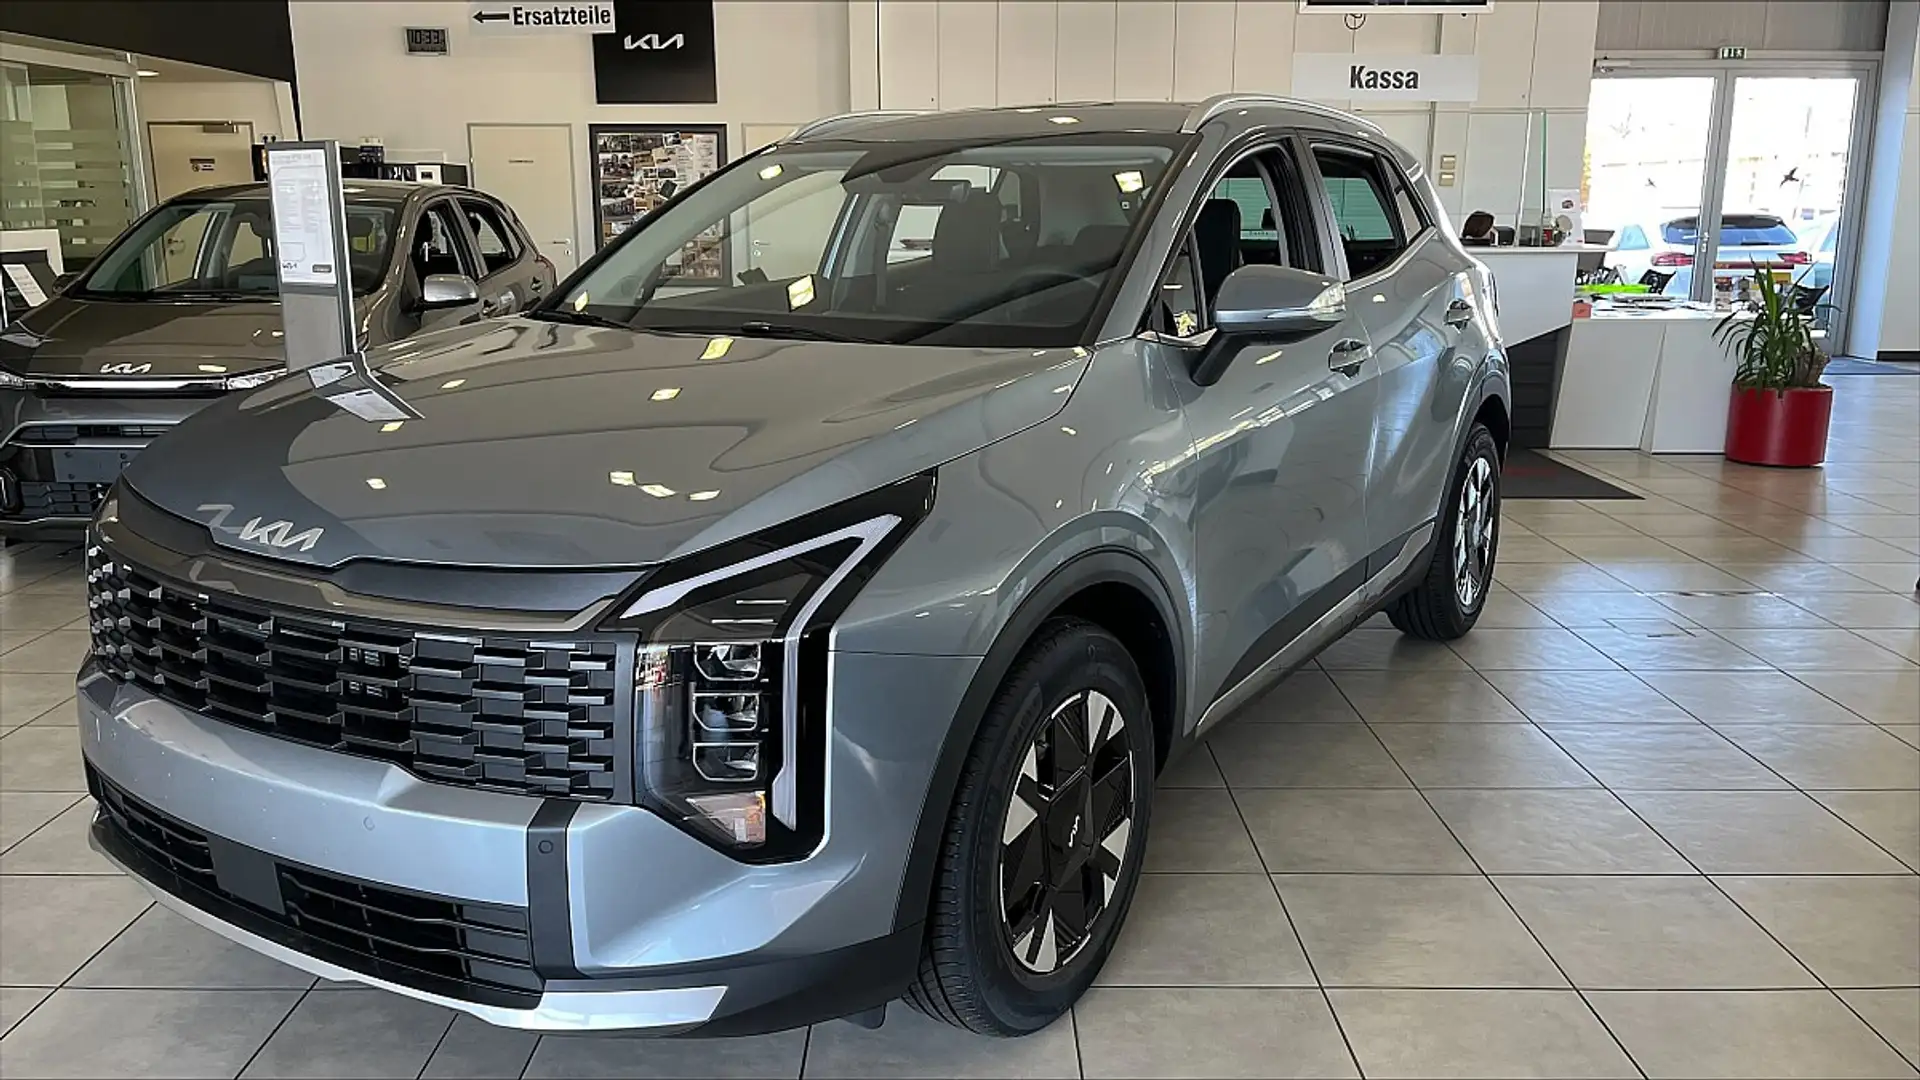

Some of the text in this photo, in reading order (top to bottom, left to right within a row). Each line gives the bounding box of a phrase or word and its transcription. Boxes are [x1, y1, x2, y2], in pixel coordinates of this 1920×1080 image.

[512, 6, 611, 26] Ersatzteile
[1349, 65, 1420, 90] Kassa
[238, 516, 325, 552] KIA
